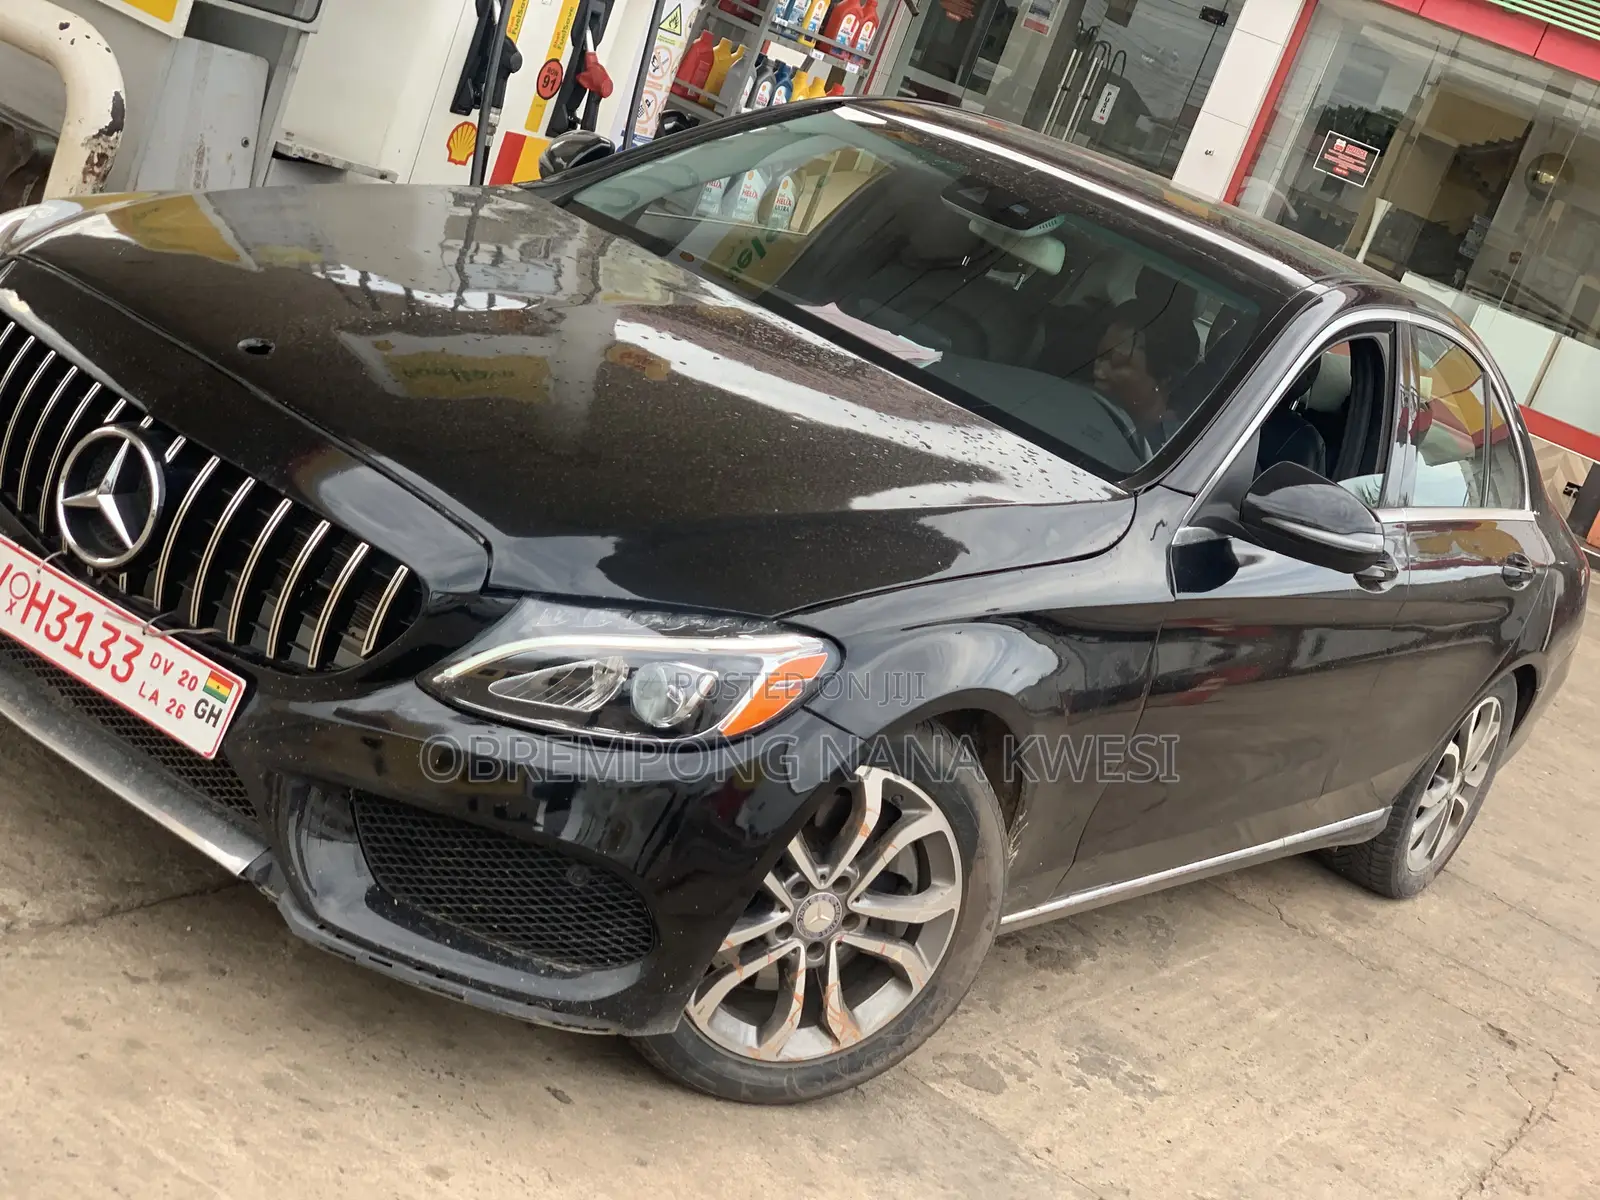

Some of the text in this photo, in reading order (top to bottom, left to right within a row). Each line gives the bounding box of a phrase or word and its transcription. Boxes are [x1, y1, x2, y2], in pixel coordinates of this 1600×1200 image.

[557, 6, 575, 50] FuelServe
[542, 74, 557, 92] 91
[1100, 91, 1112, 114] PUSH
[774, 204, 790, 213] ULTRA
[776, 197, 792, 207] HELIX
[149, 652, 199, 692] DV 20
[138, 681, 187, 719] LA 26
[194, 698, 223, 728] GH
